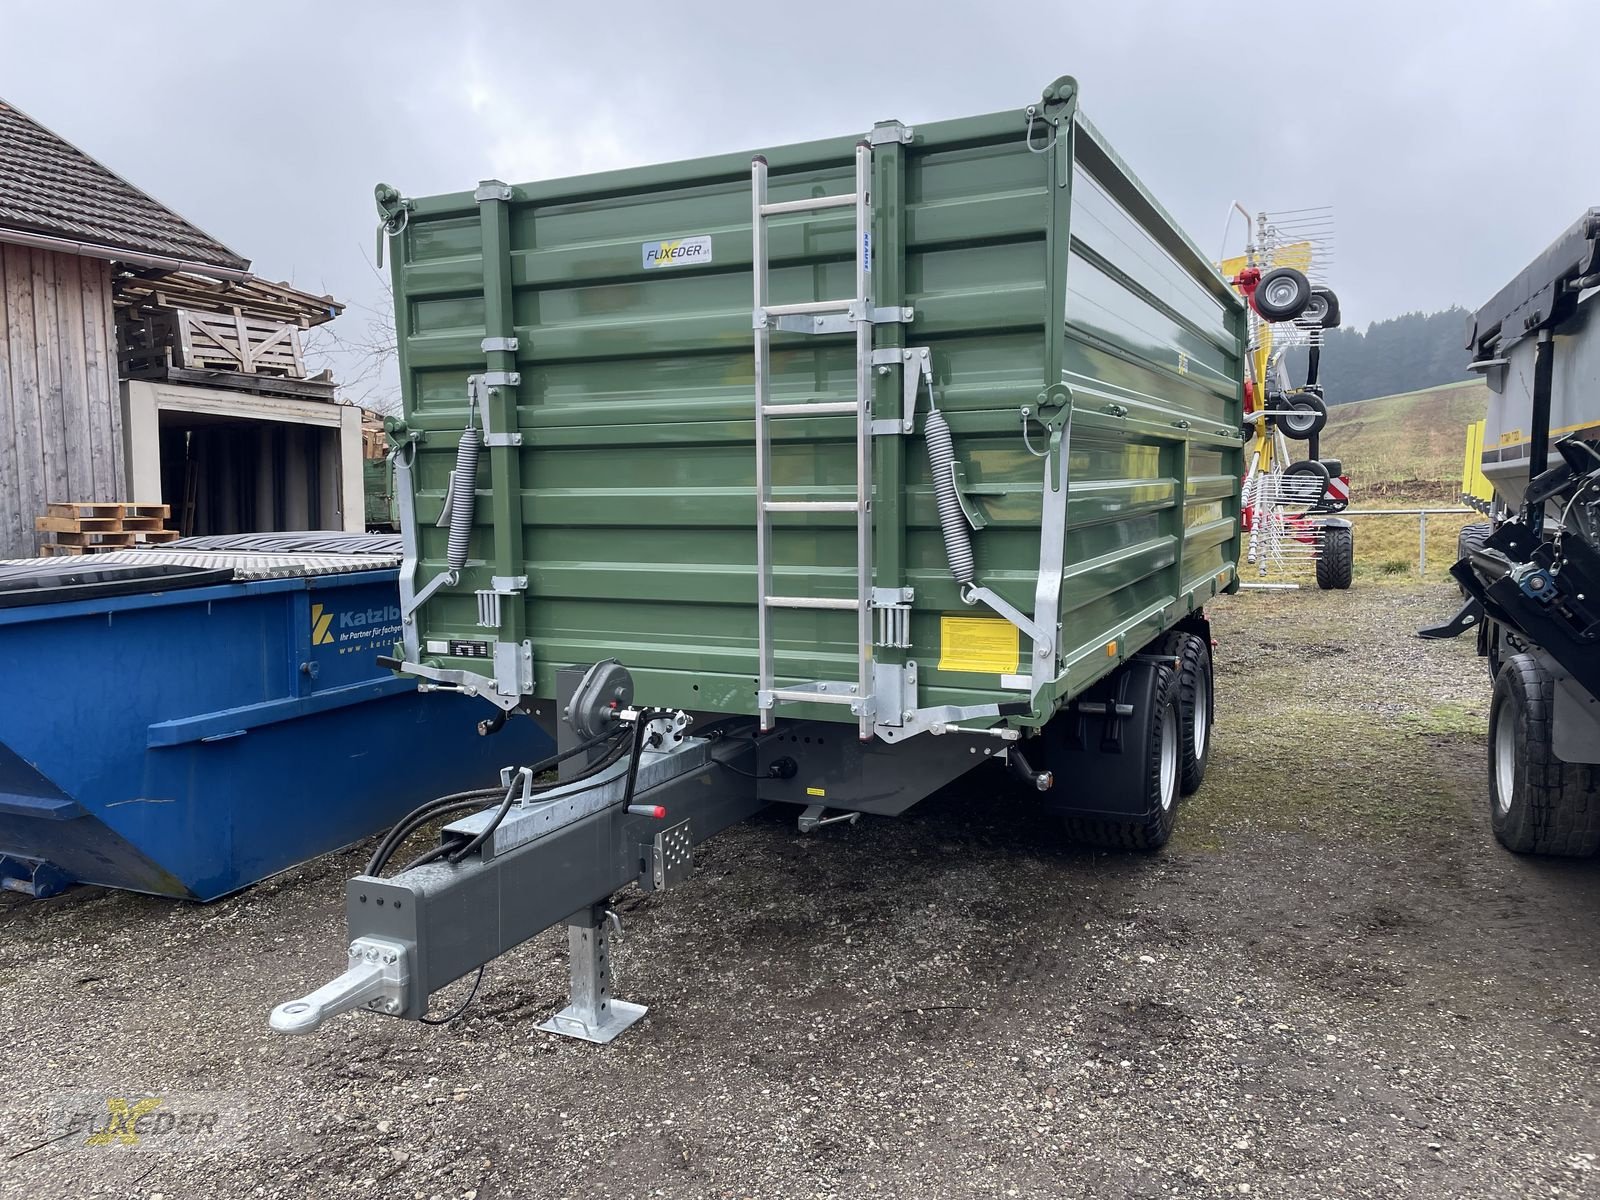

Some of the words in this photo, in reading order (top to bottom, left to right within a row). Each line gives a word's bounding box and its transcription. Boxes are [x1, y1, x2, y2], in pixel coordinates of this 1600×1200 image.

[646, 244, 702, 261] FLIXEDER
[340, 632, 349, 641] Ihr
[349, 630, 372, 640] Partner
[371, 627, 382, 638] für
